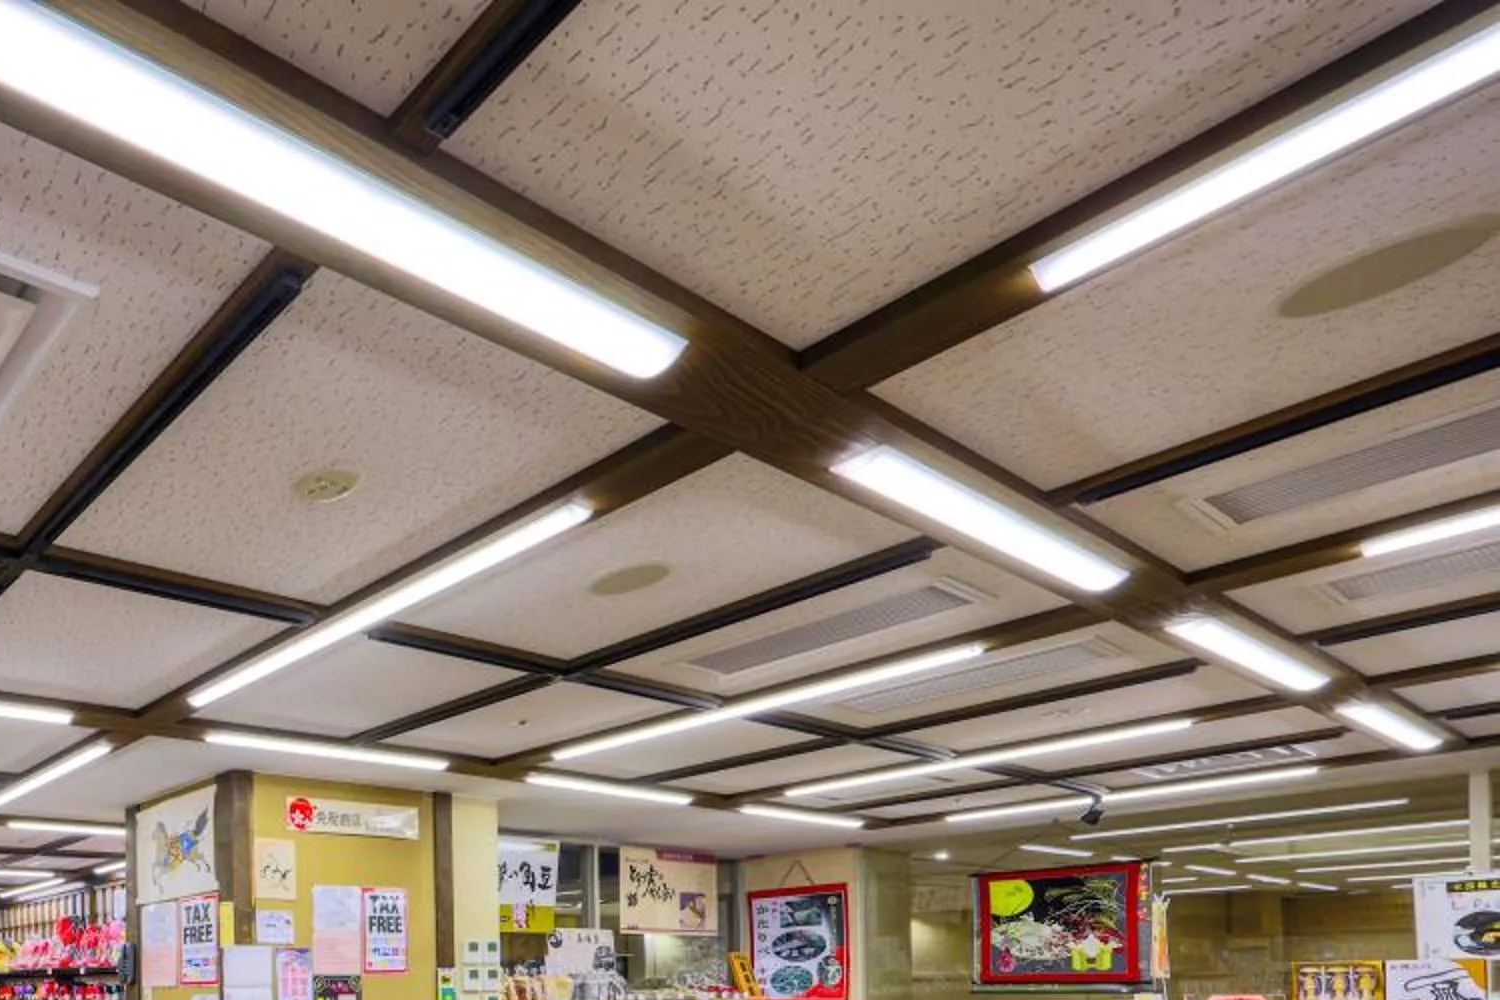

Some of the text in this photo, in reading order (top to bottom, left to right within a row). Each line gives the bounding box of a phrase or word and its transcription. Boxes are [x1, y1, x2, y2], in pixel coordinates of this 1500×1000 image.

[185, 903, 211, 924] TAX
[368, 895, 400, 914] TAX
[368, 915, 403, 933] FREE
[184, 924, 213, 944] FREE
